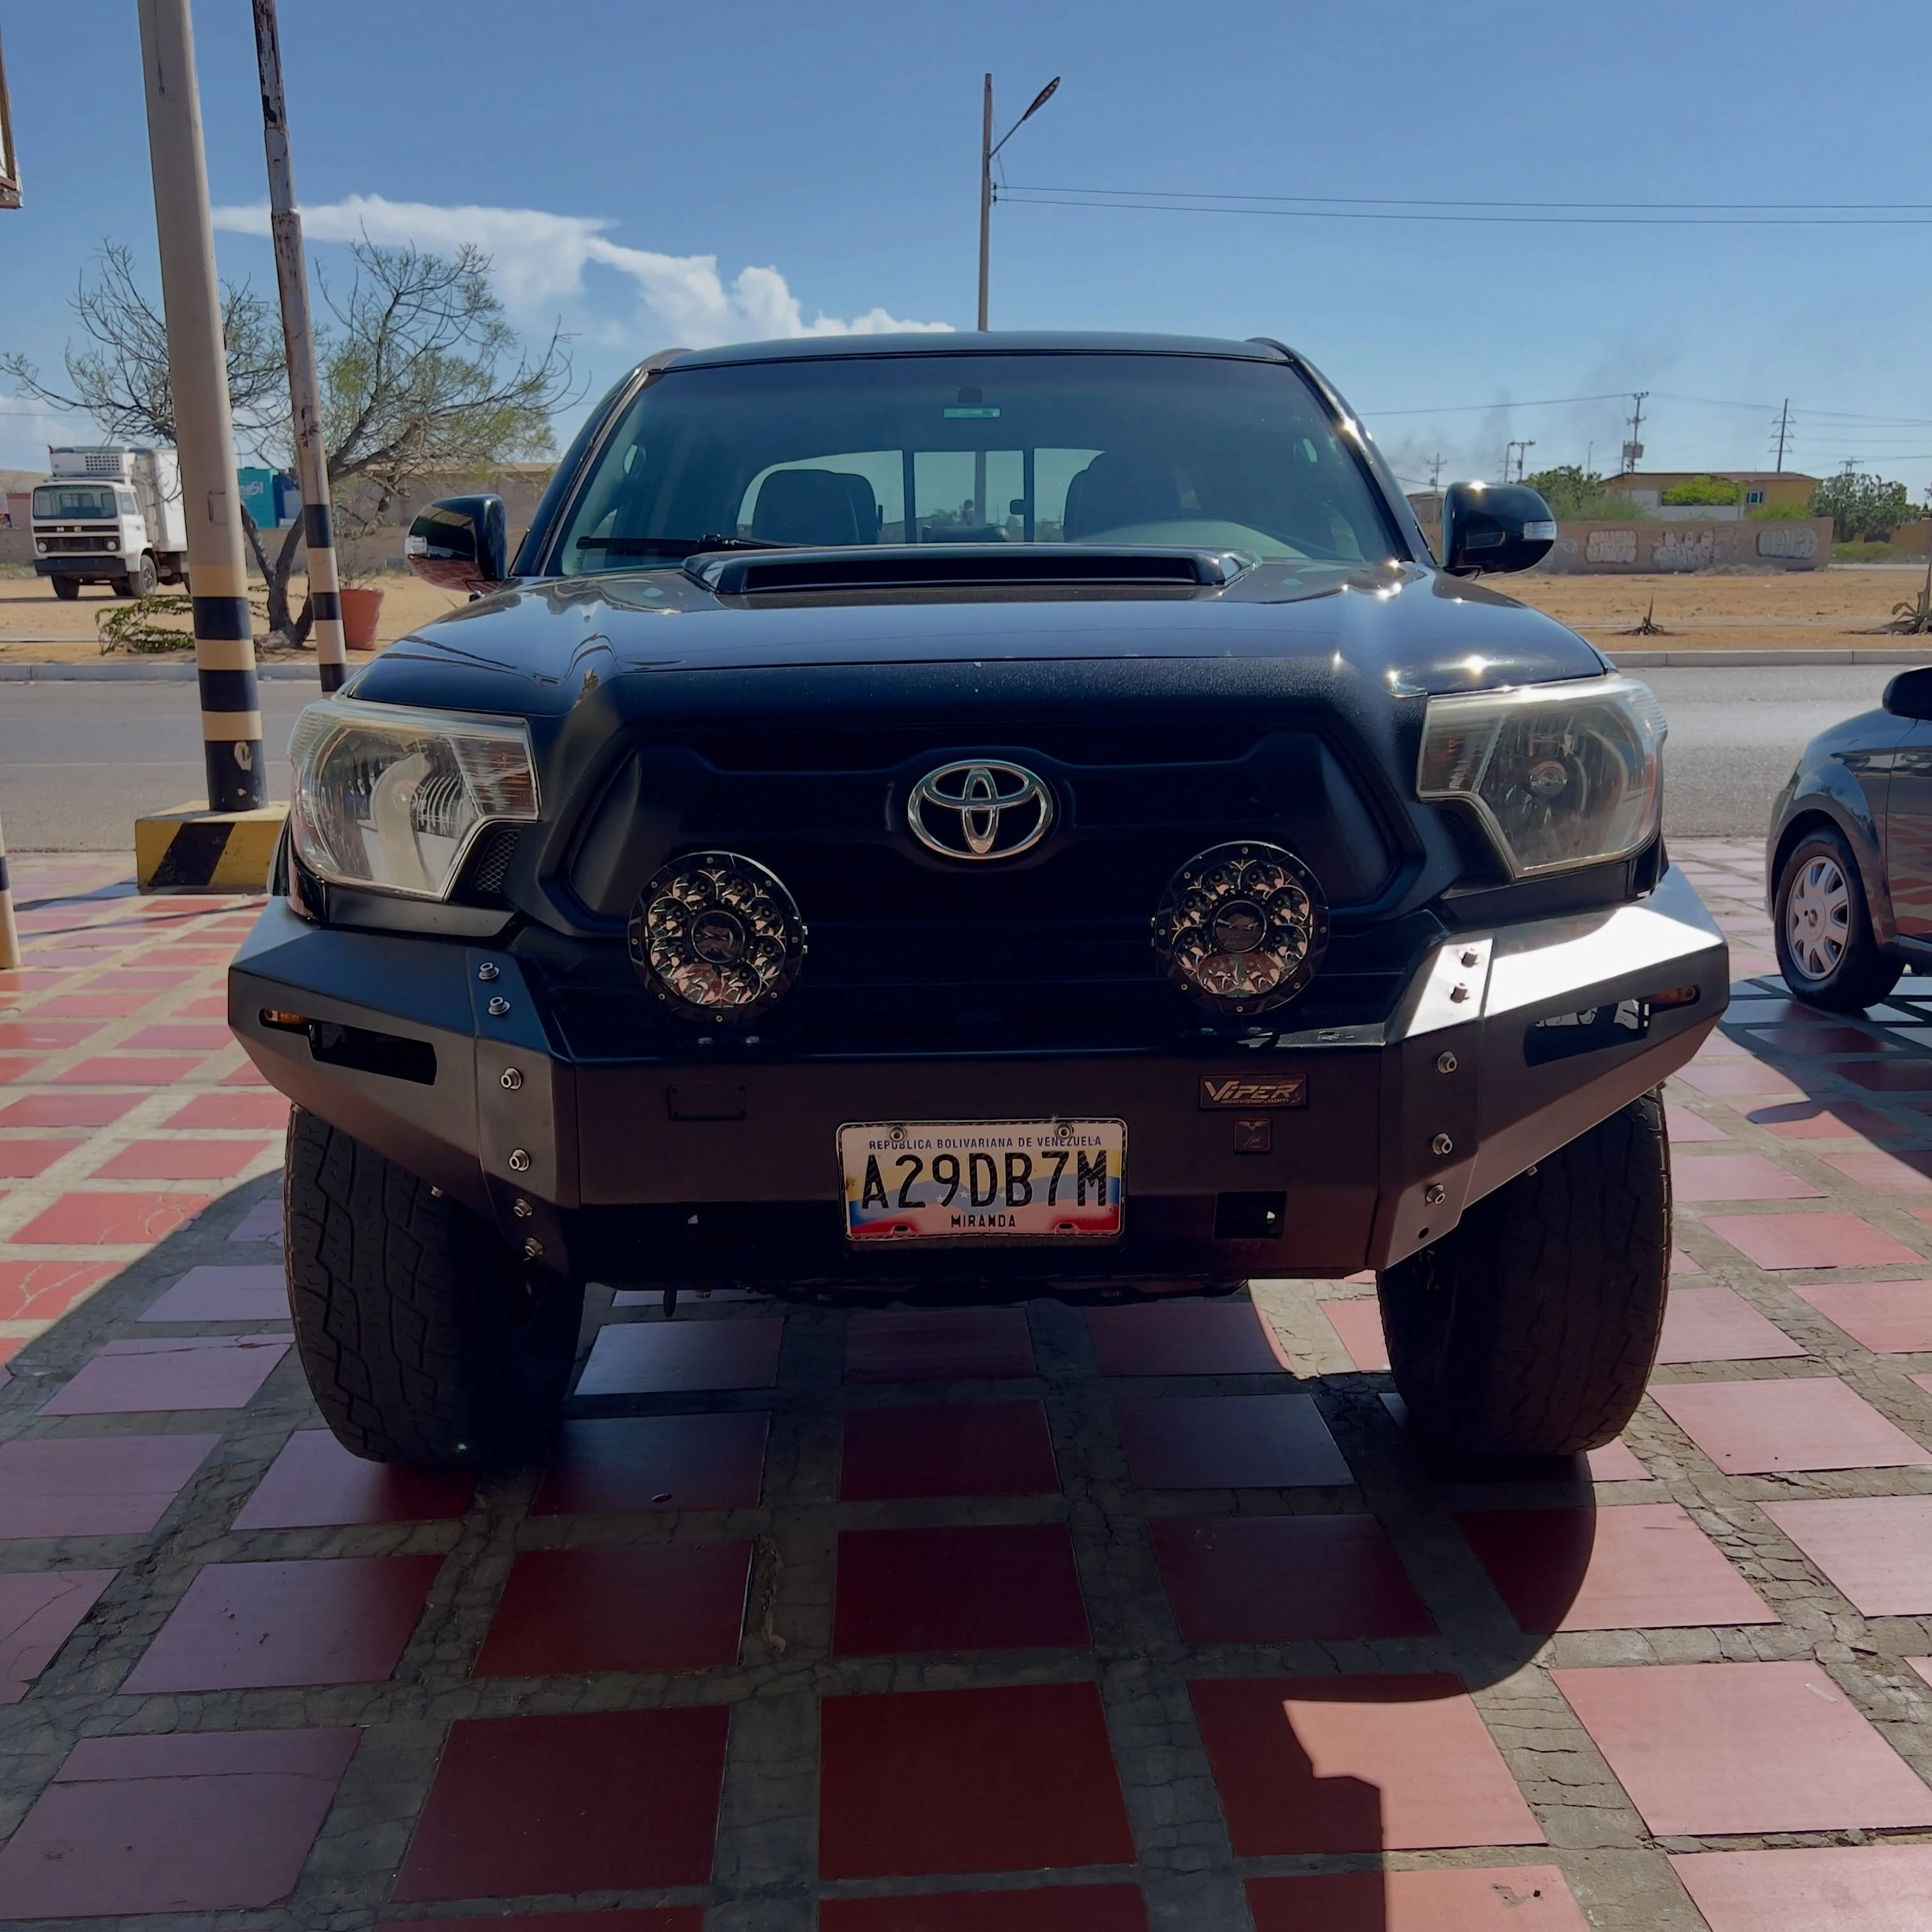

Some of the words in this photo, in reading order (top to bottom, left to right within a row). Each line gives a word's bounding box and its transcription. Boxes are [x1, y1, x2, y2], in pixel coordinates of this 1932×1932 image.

[937, 1137, 1013, 1149] BOLIVARIANA
[1018, 1137, 1033, 1147] DE
[1037, 1135, 1101, 1147] VENEZUELA
[862, 1150, 1107, 1209] A29DB7M
[951, 1215, 1016, 1228] MIRANDA
